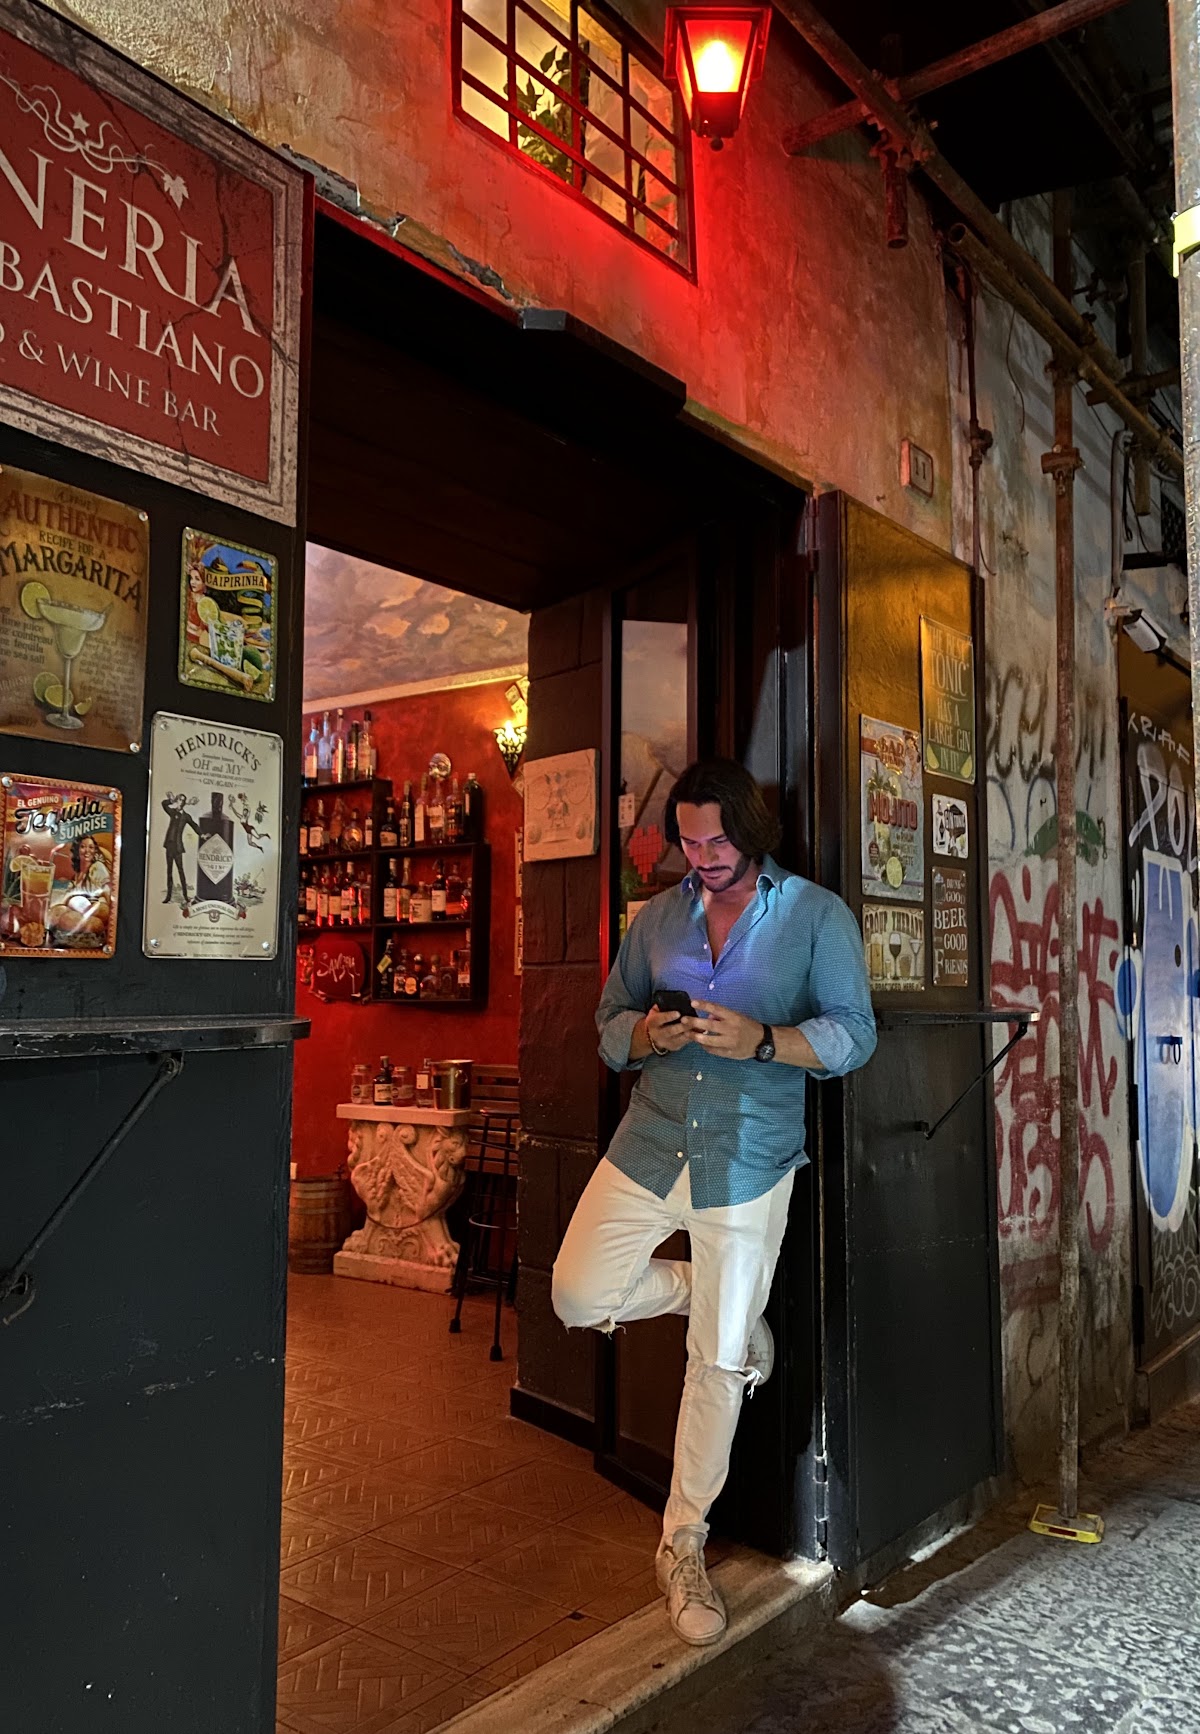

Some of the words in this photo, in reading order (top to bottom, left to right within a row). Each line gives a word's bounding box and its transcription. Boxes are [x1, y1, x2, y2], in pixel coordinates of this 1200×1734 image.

[0, 239, 264, 398] BASTIANO
[18, 329, 47, 366] &
[53, 340, 150, 408] WINE
[163, 386, 221, 437] BAR
[2, 489, 138, 553] AUTHENTIC
[39, 530, 75, 550] RECIPE
[77, 541, 95, 556] FOR
[98, 550, 107, 561] A
[0, 541, 141, 612] MARGARITA
[206, 573, 265, 588] CAIPIRINHA
[928, 625, 943, 652] THE
[945, 632, 967, 661] BEST
[929, 650, 967, 696] TONIC
[937, 697, 953, 723] HAS
[953, 703, 960, 727] A
[174, 732, 261, 771] HENDRICK'S
[928, 718, 956, 748] LARGE
[956, 729, 971, 753] GIN
[940, 747, 949, 771] IN
[14, 796, 105, 836] Tequila
[17, 799, 25, 807] EL
[27, 796, 59, 807] GENUINO
[868, 790, 918, 831] MOJITO
[60, 816, 107, 840] SUNRISE
[945, 890, 966, 905] GOOD
[864, 910, 888, 943] GROUP
[891, 910, 923, 941] THERAPY
[933, 907, 967, 930] BEER
[943, 933, 967, 951] GOOD
[933, 949, 968, 981] FRIENDS
